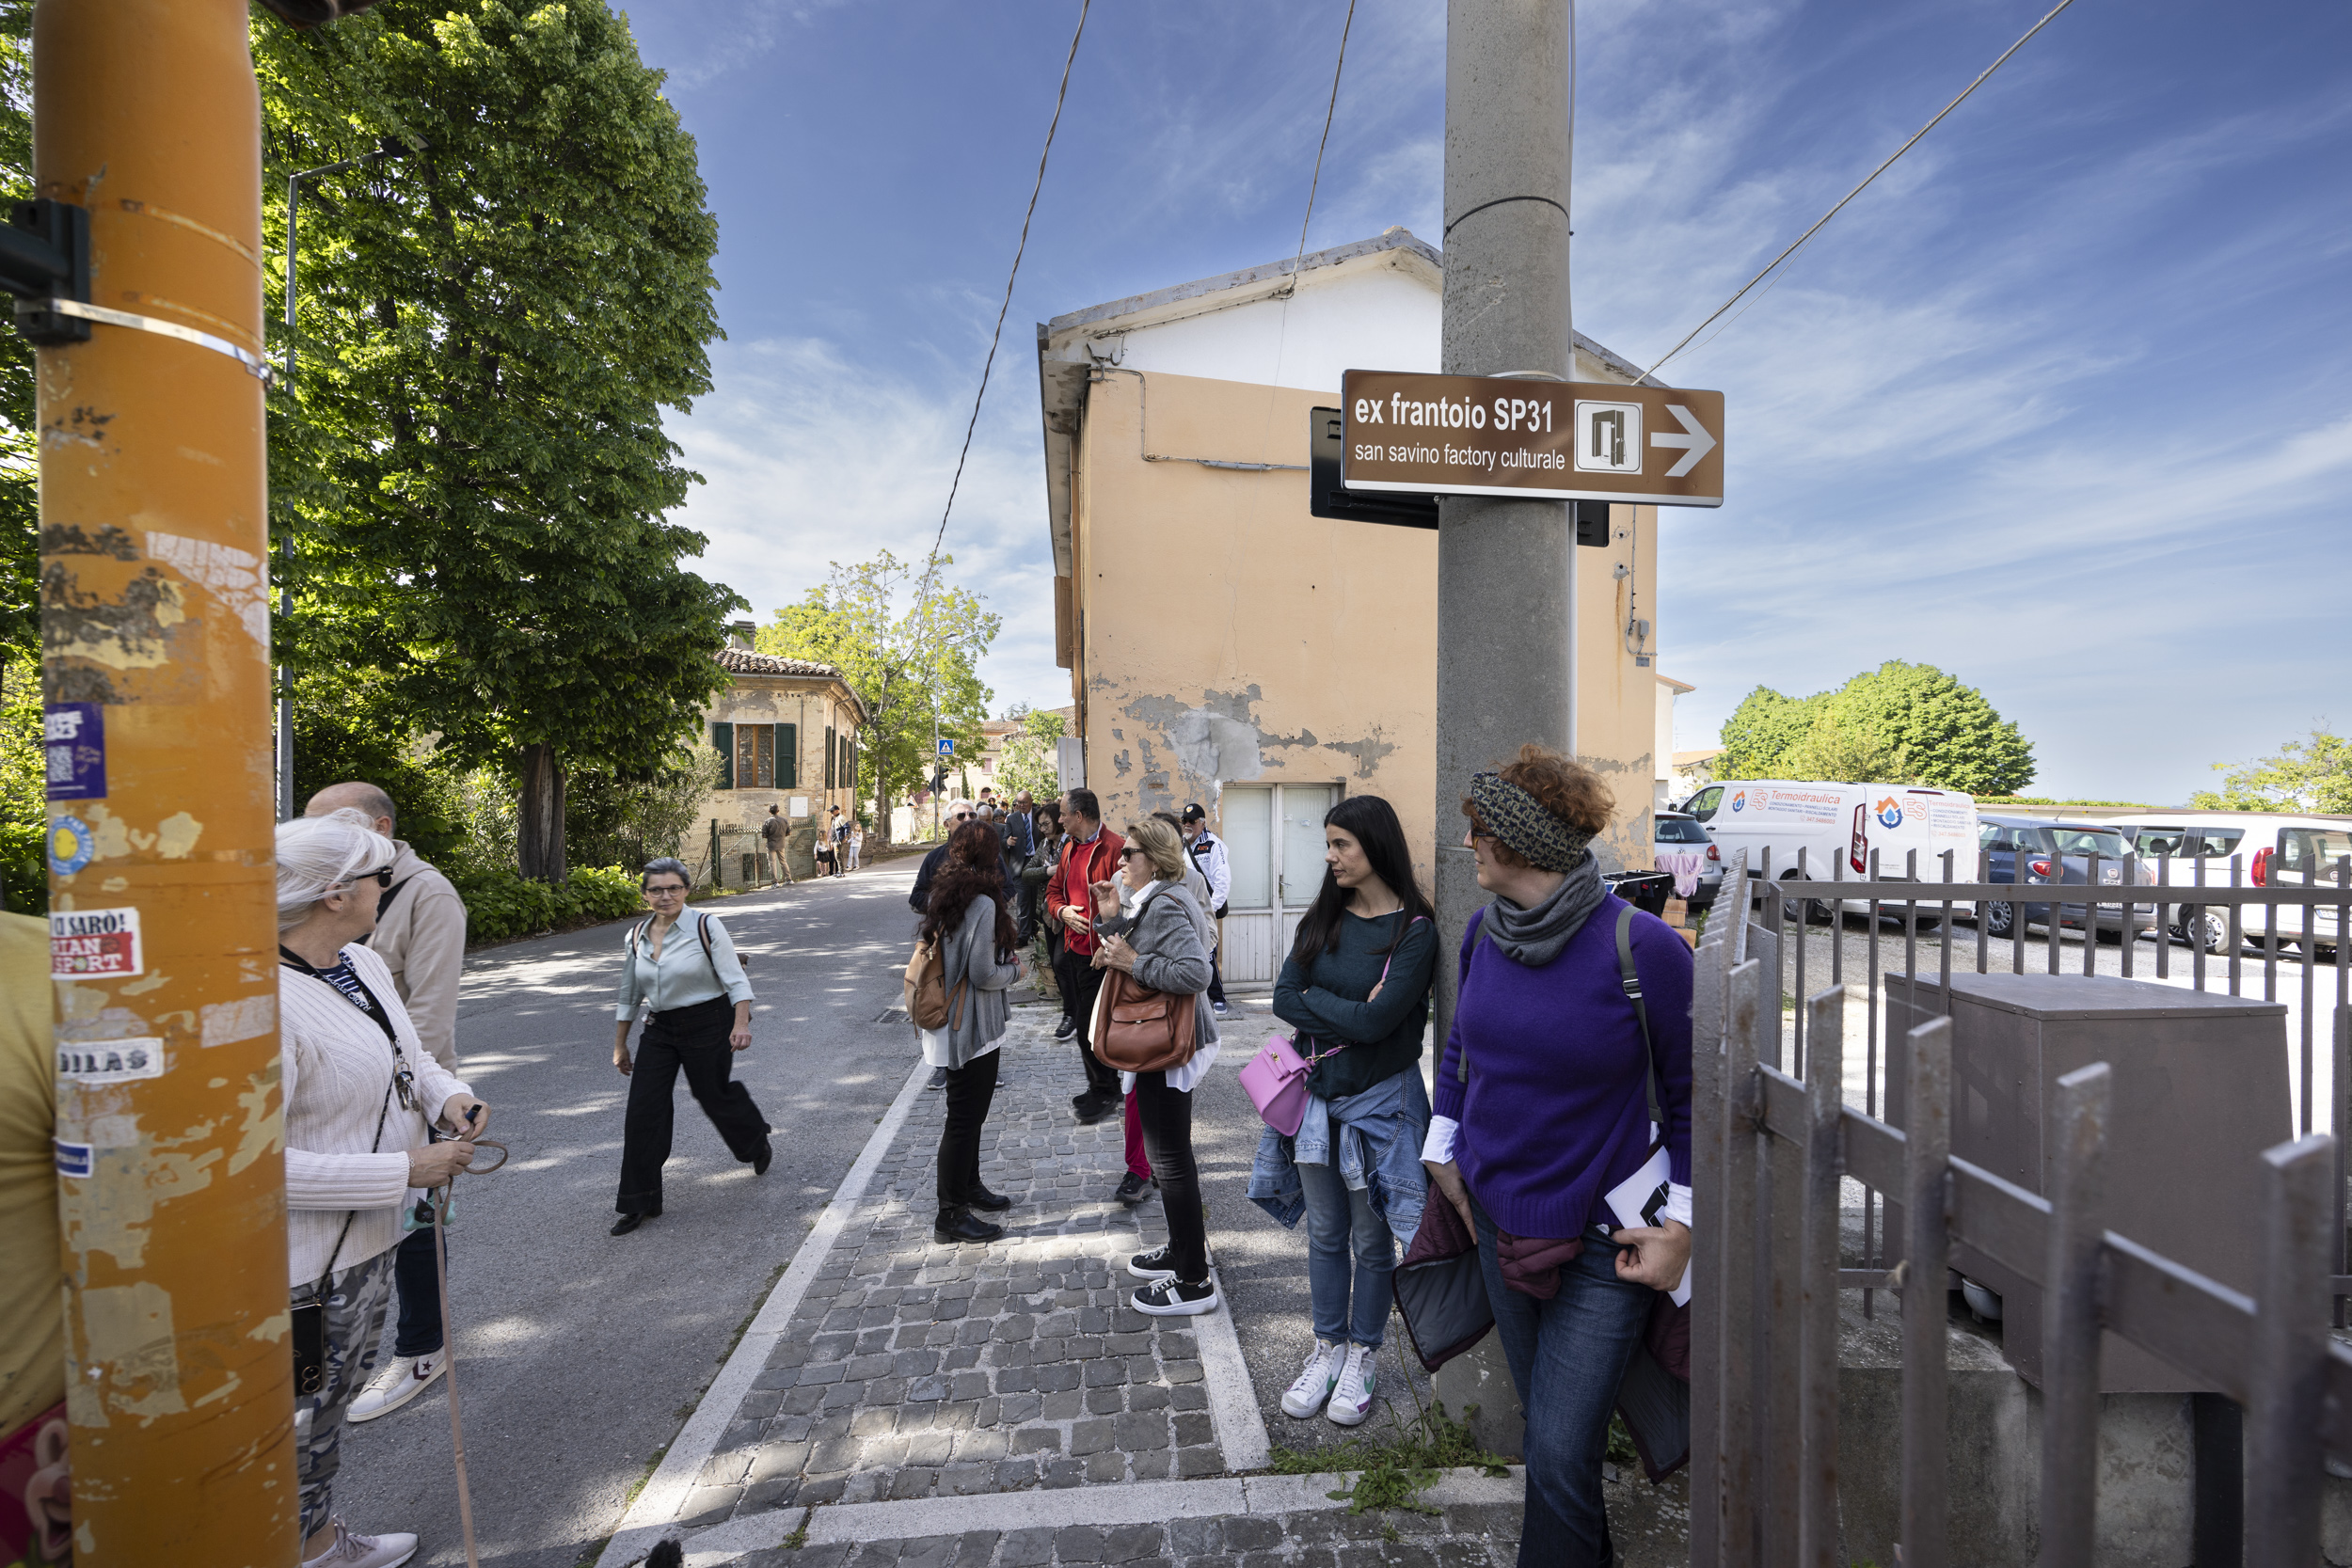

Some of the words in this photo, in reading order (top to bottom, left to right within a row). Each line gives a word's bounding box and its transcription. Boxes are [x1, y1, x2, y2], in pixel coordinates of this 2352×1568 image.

[1355, 397, 1384, 425] ex
[1391, 392, 1486, 430] frantoio
[1493, 397, 1552, 433] SP31
[1355, 443, 1384, 461] san
[1389, 442, 1439, 465] savino
[1444, 444, 1496, 471] factory
[1501, 447, 1565, 470] culturale
[1771, 790, 1841, 804] Termoidraulica
[1929, 800, 1971, 809] Termoidraulica
[347, 992, 372, 1012] RADIO
